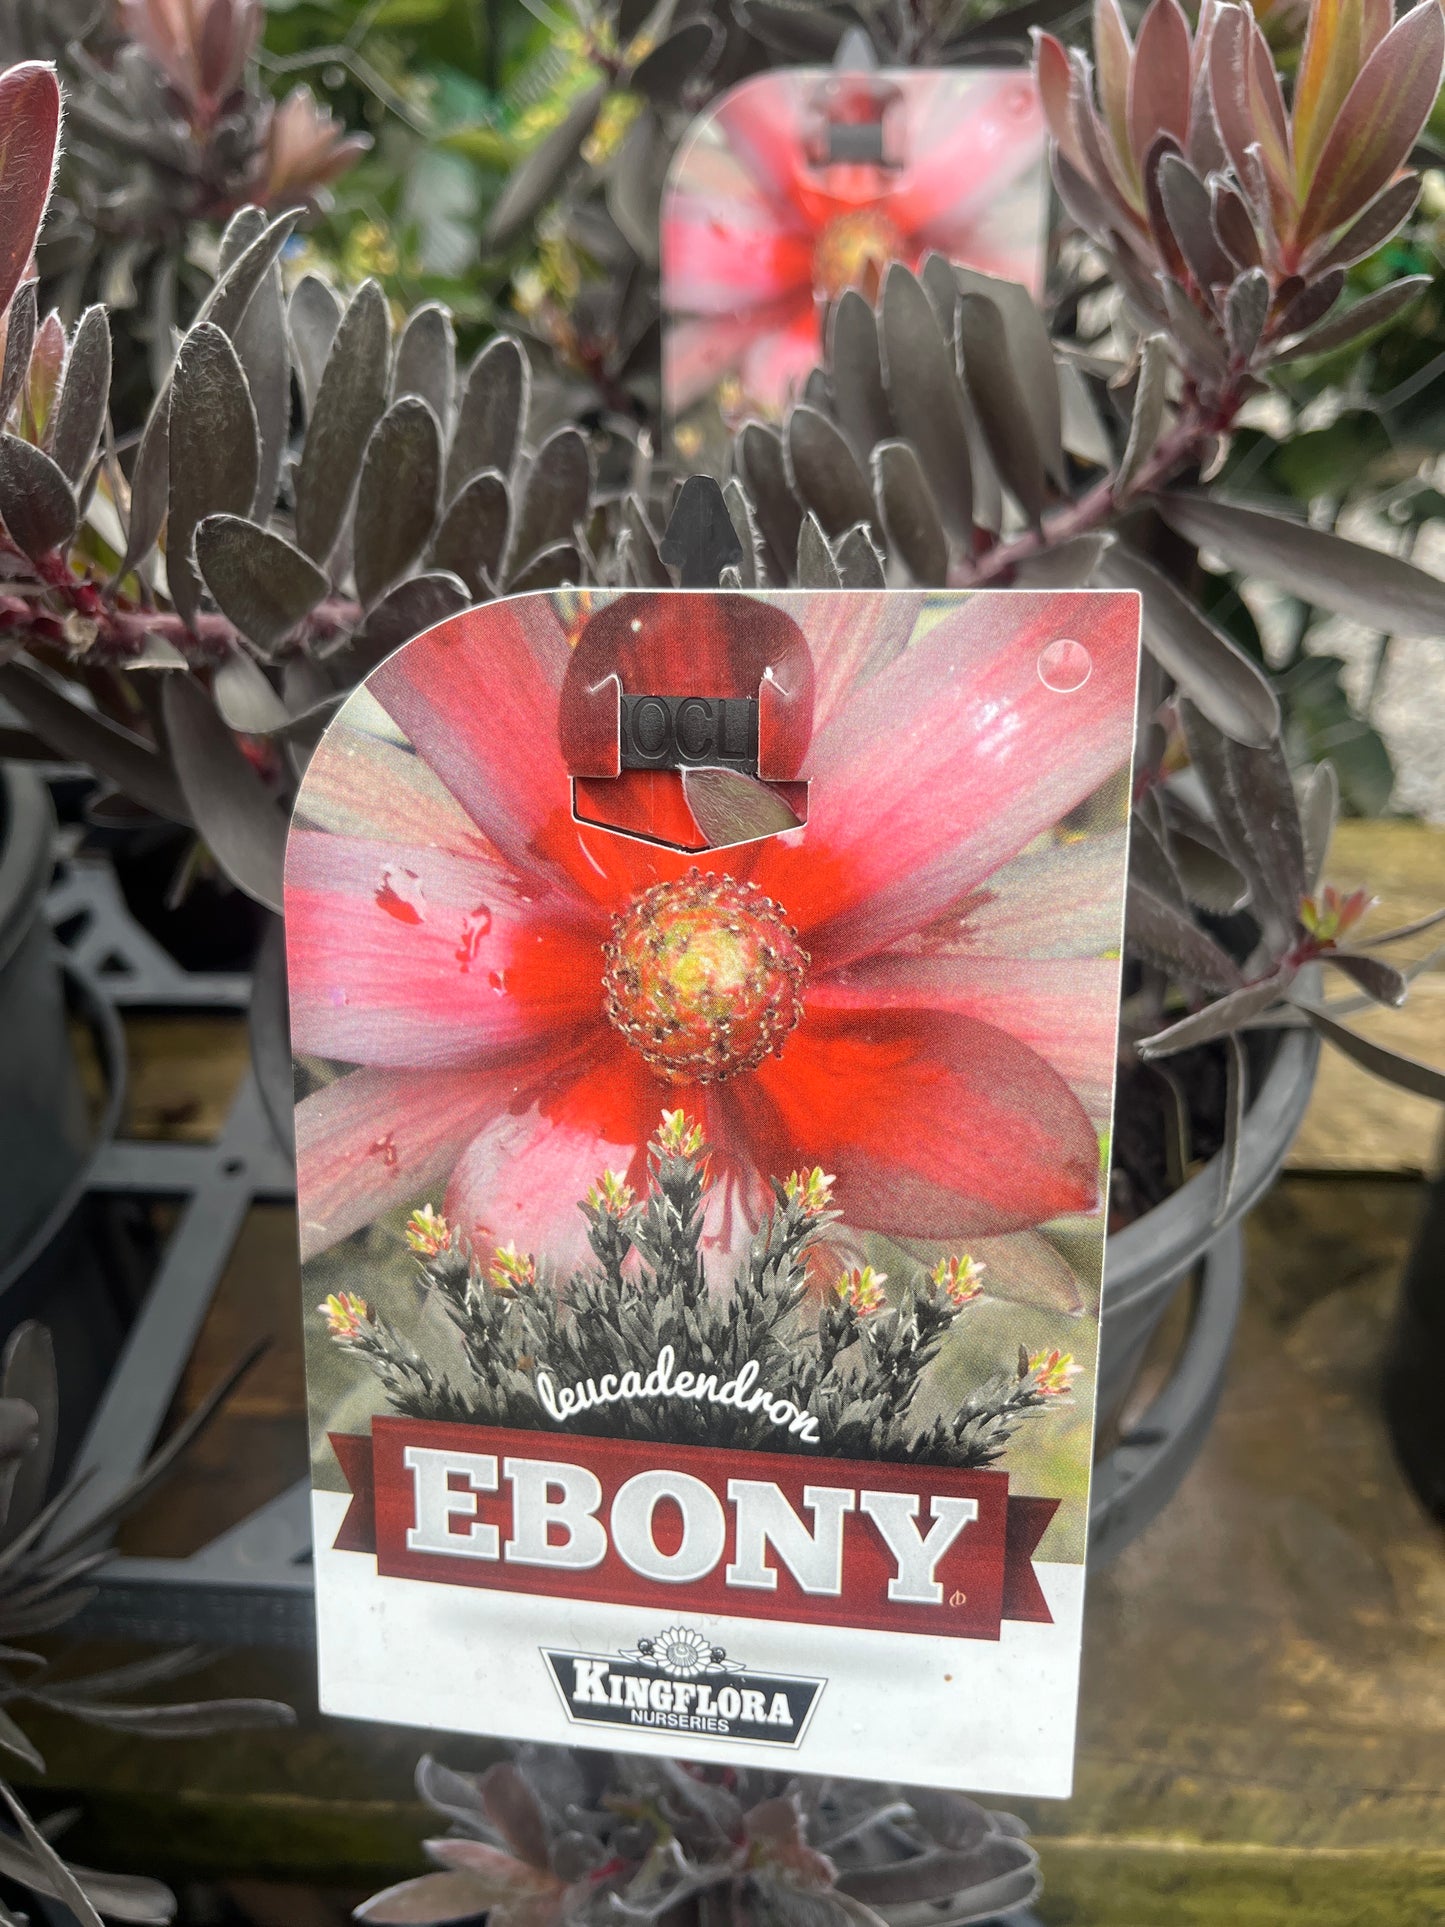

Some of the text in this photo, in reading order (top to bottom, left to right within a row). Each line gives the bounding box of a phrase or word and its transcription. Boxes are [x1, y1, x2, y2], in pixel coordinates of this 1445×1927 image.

[537, 1344, 820, 1443] leucadendron
[404, 1446, 979, 1604] EBONY
[630, 1708, 730, 1732] NURSERIES
